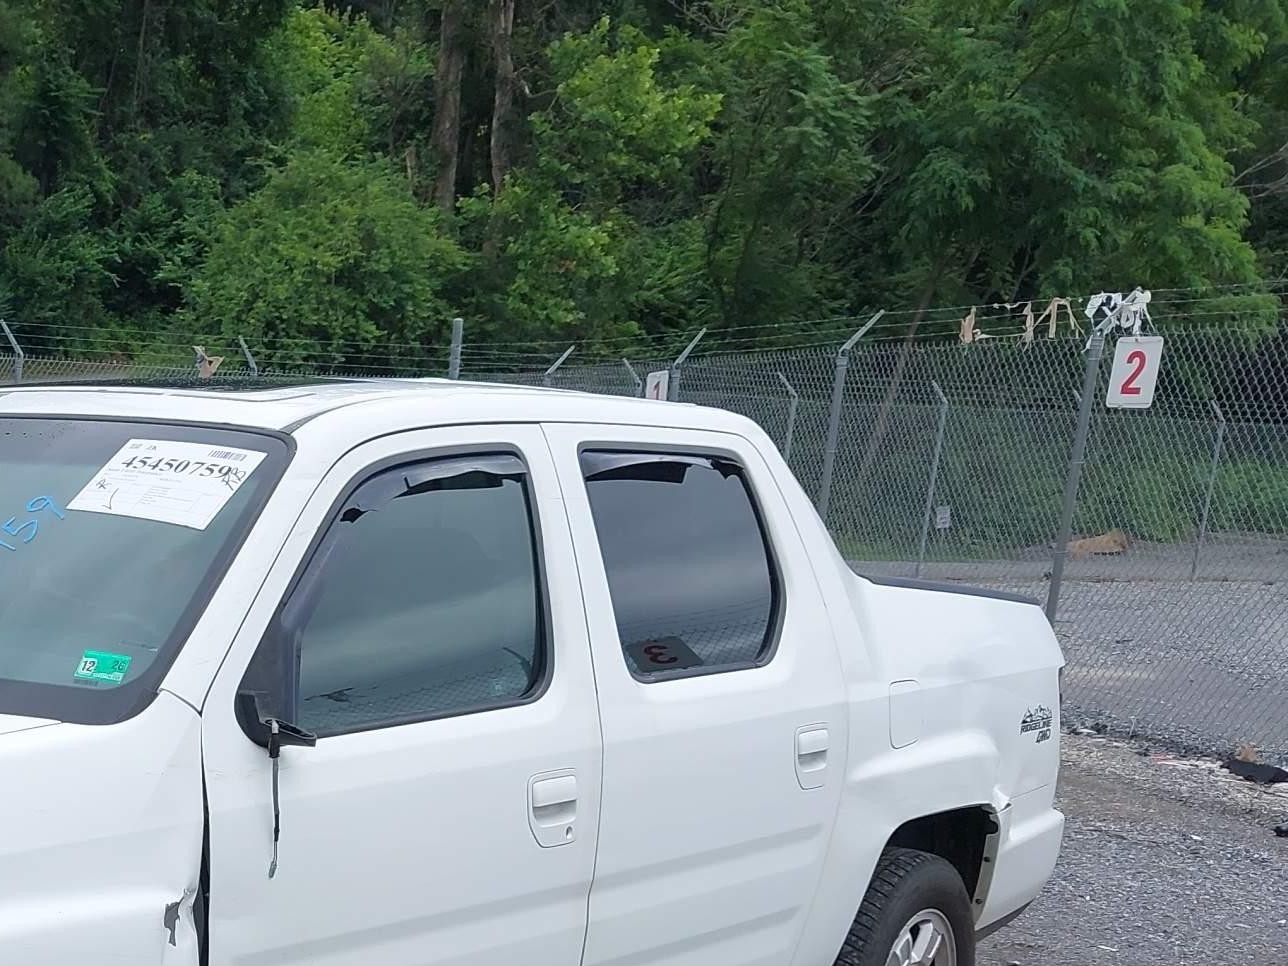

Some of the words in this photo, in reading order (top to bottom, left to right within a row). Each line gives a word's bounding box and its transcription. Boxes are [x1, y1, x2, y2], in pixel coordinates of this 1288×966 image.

[1120, 350, 1146, 395] 2
[653, 381, 661, 400] 1
[121, 455, 234, 479] 45450759
[81, 660, 96, 672] 12
[111, 660, 126, 671] 26
